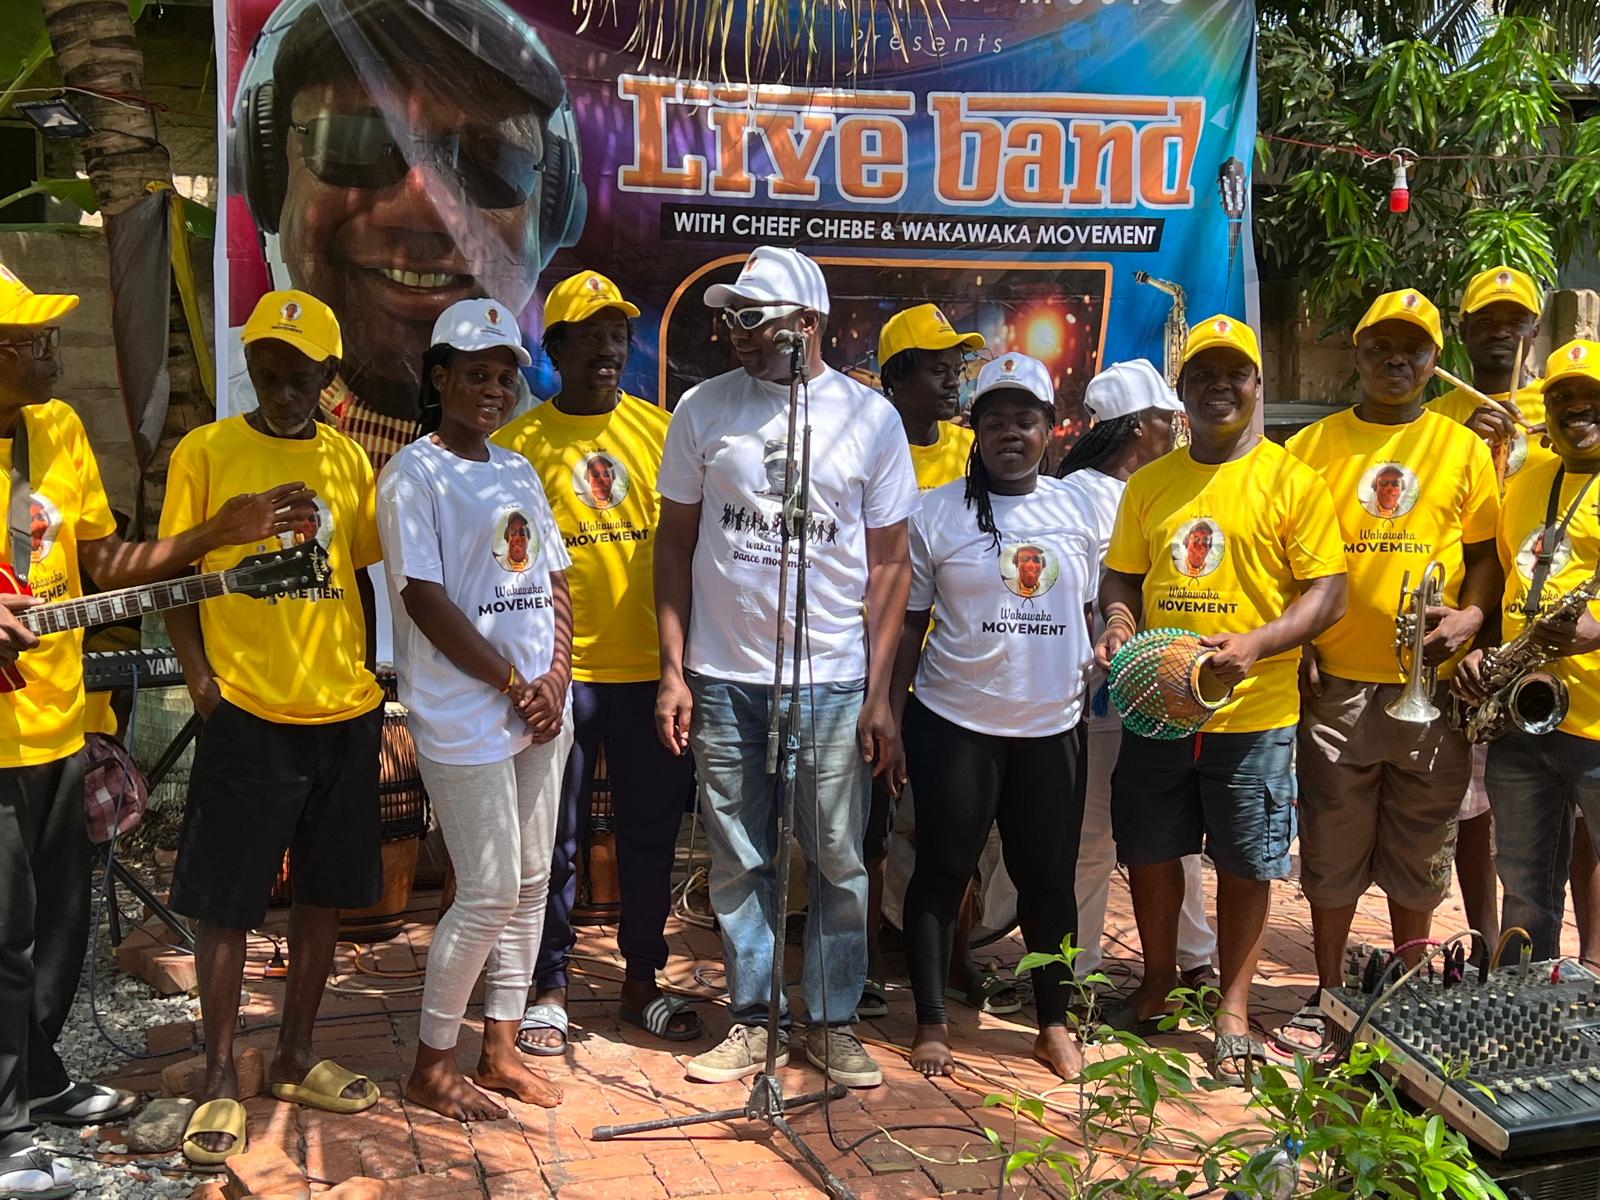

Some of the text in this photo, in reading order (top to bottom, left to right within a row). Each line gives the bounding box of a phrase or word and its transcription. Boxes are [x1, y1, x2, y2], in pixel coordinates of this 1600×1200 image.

[850, 29, 1003, 53] Presents
[618, 74, 1206, 209] Live band
[674, 211, 1156, 245] WITH CHEEF CHEBE & WAKAWAKA MOVEMENT
[579, 518, 632, 533] Wakawaka
[566, 529, 649, 548] MOVEMENT
[1360, 528, 1416, 540] Wakawaka
[1344, 542, 1432, 554] MOVEMENT
[733, 551, 760, 563] Dance
[495, 582, 544, 599] Wakawaka
[1168, 585, 1220, 600] Wakawaka
[478, 596, 553, 616] MOVEMEN
[1158, 600, 1238, 614] MOVEMENT
[1001, 607, 1053, 621] Wakawaka
[982, 621, 1066, 636] MOVEMENT
[146, 657, 183, 675] YAM
